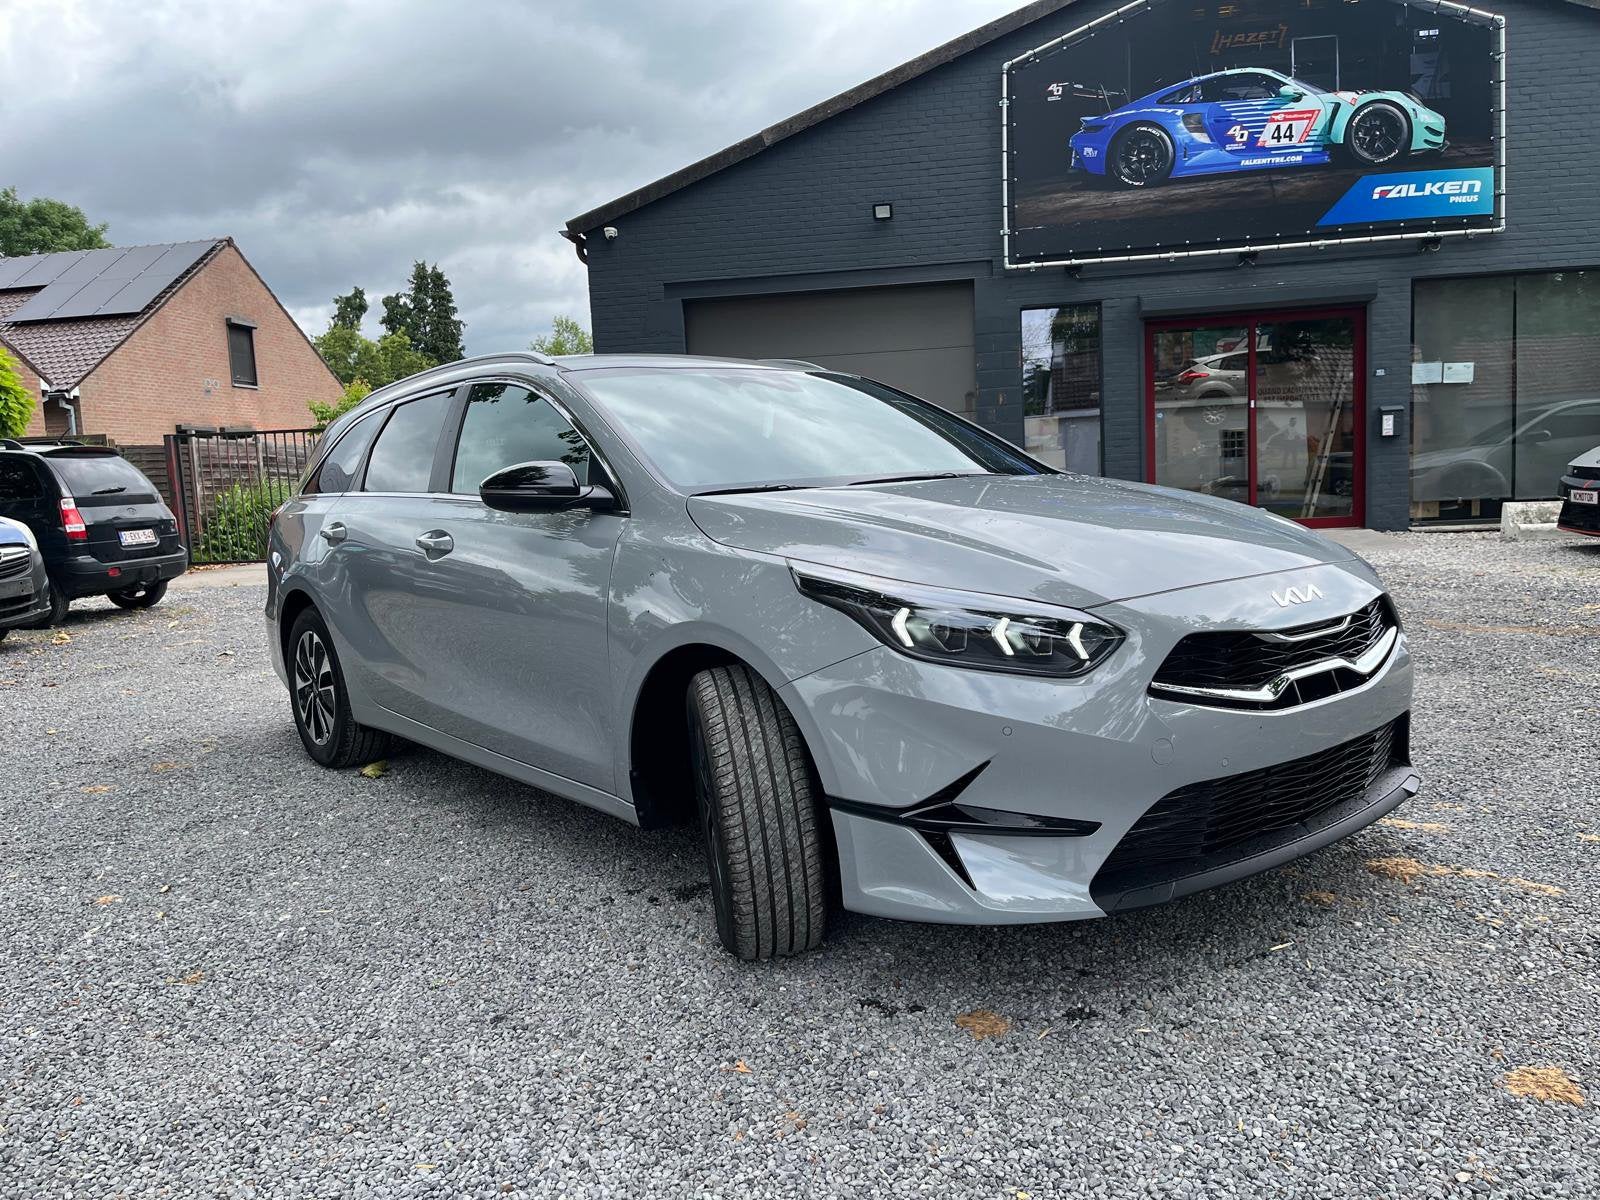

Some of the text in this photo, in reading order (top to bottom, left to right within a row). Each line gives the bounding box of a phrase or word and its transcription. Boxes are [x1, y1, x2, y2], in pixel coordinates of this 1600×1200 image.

[1217, 30, 1281, 49] HAZET
[1271, 123, 1294, 143] 44
[1240, 155, 1303, 166] FALKENTYRE.COM
[1372, 180, 1482, 200] FALKEN
[1449, 194, 1479, 203] PNEUS
[1271, 584, 1323, 607] KIA
